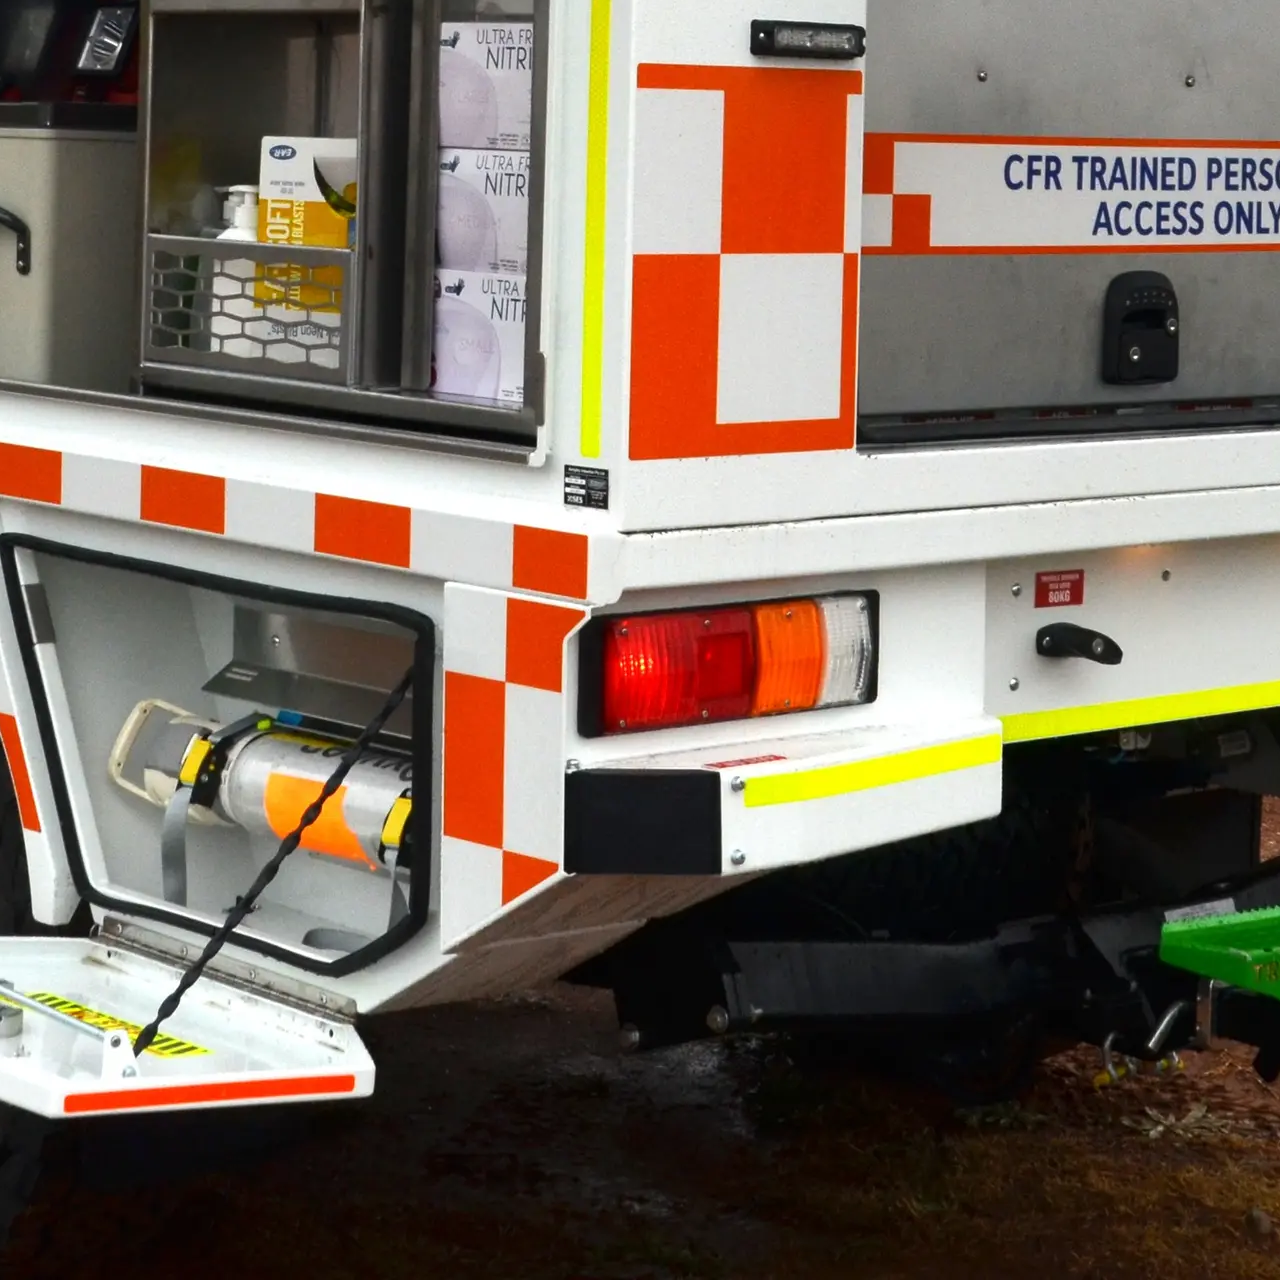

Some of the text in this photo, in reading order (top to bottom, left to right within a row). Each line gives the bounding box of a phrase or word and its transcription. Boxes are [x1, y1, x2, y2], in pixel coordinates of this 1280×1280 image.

[476, 28, 514, 45] ULTRA
[476, 154, 514, 171] ULTRA
[1004, 154, 1062, 193] CFR
[1071, 154, 1197, 193] TRAINED
[1092, 199, 1204, 237] ACCESS
[481, 278, 520, 297] ULTRA
